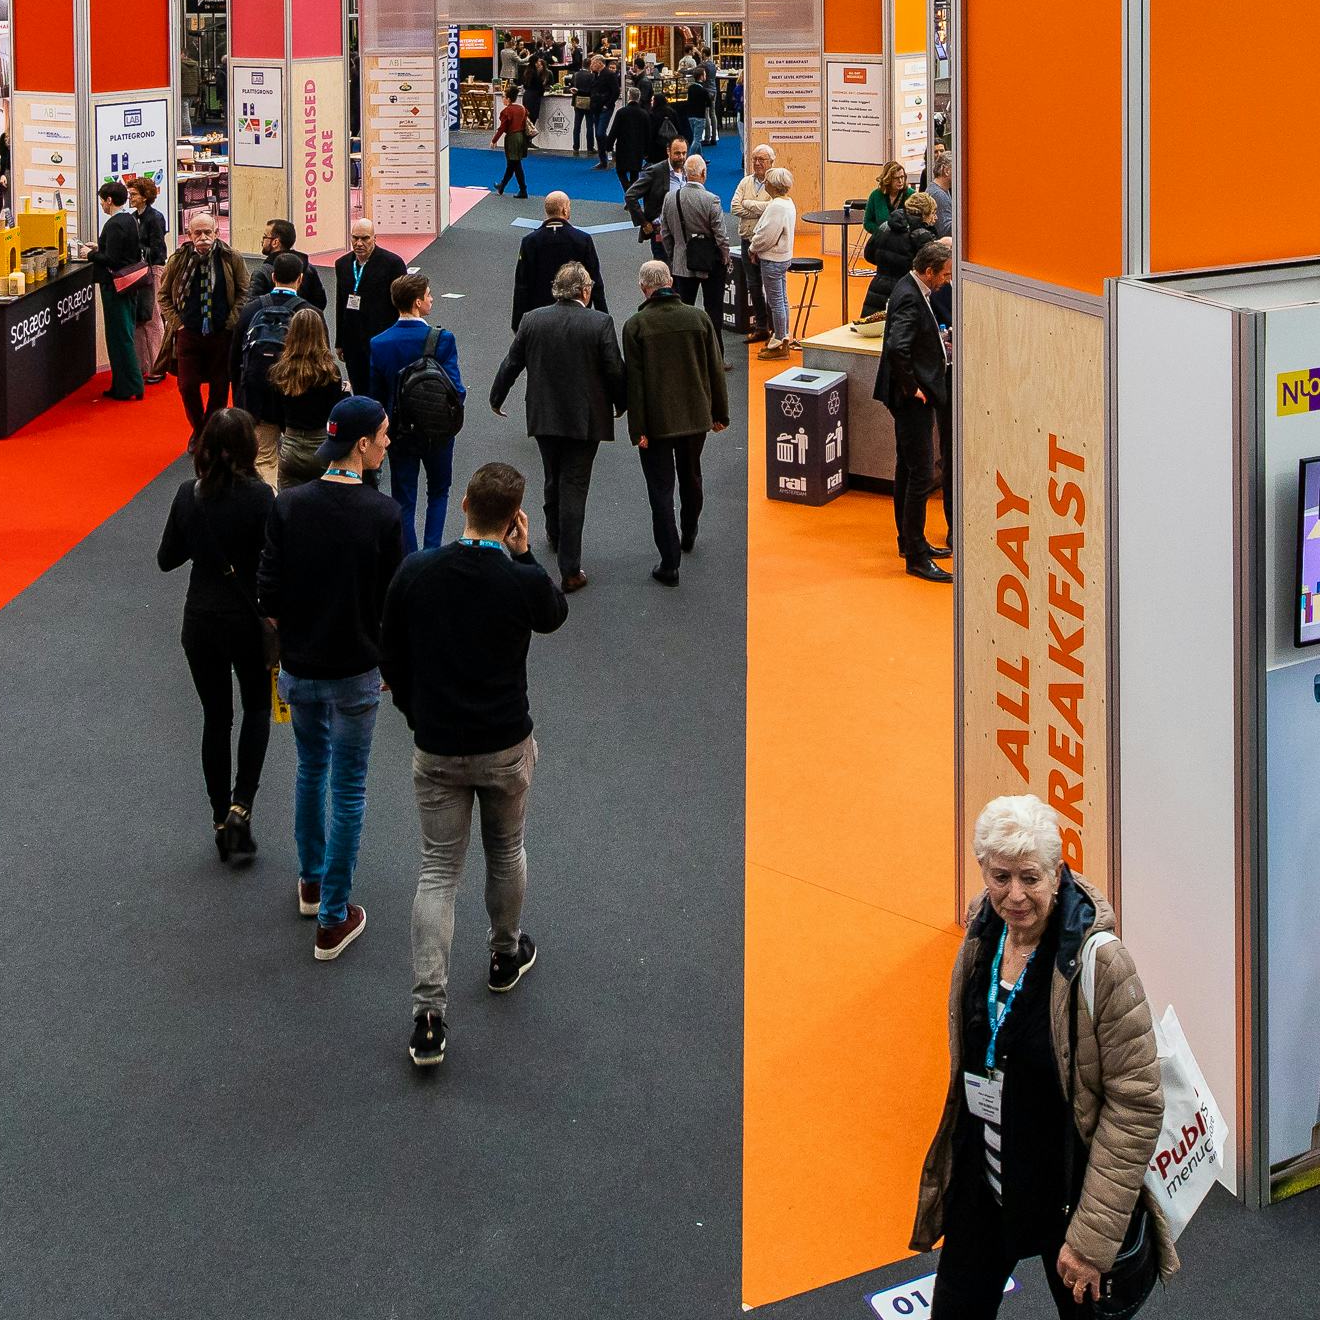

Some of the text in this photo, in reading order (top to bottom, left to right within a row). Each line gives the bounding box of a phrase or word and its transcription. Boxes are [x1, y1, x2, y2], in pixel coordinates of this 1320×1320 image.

[241, 88, 274, 96] PLATTEGROND
[109, 130, 156, 142] PLATTEGROND
[304, 79, 318, 238] PERSONALISED
[322, 129, 333, 183] CARE
[779, 476, 807, 491] rai
[827, 469, 842, 489] rai
[779, 489, 807, 497] AMSTERDAM
[996, 470, 1031, 785] ALL DAY
[1047, 433, 1086, 877] BREAKFAST
[892, 1290, 930, 1315] 01
